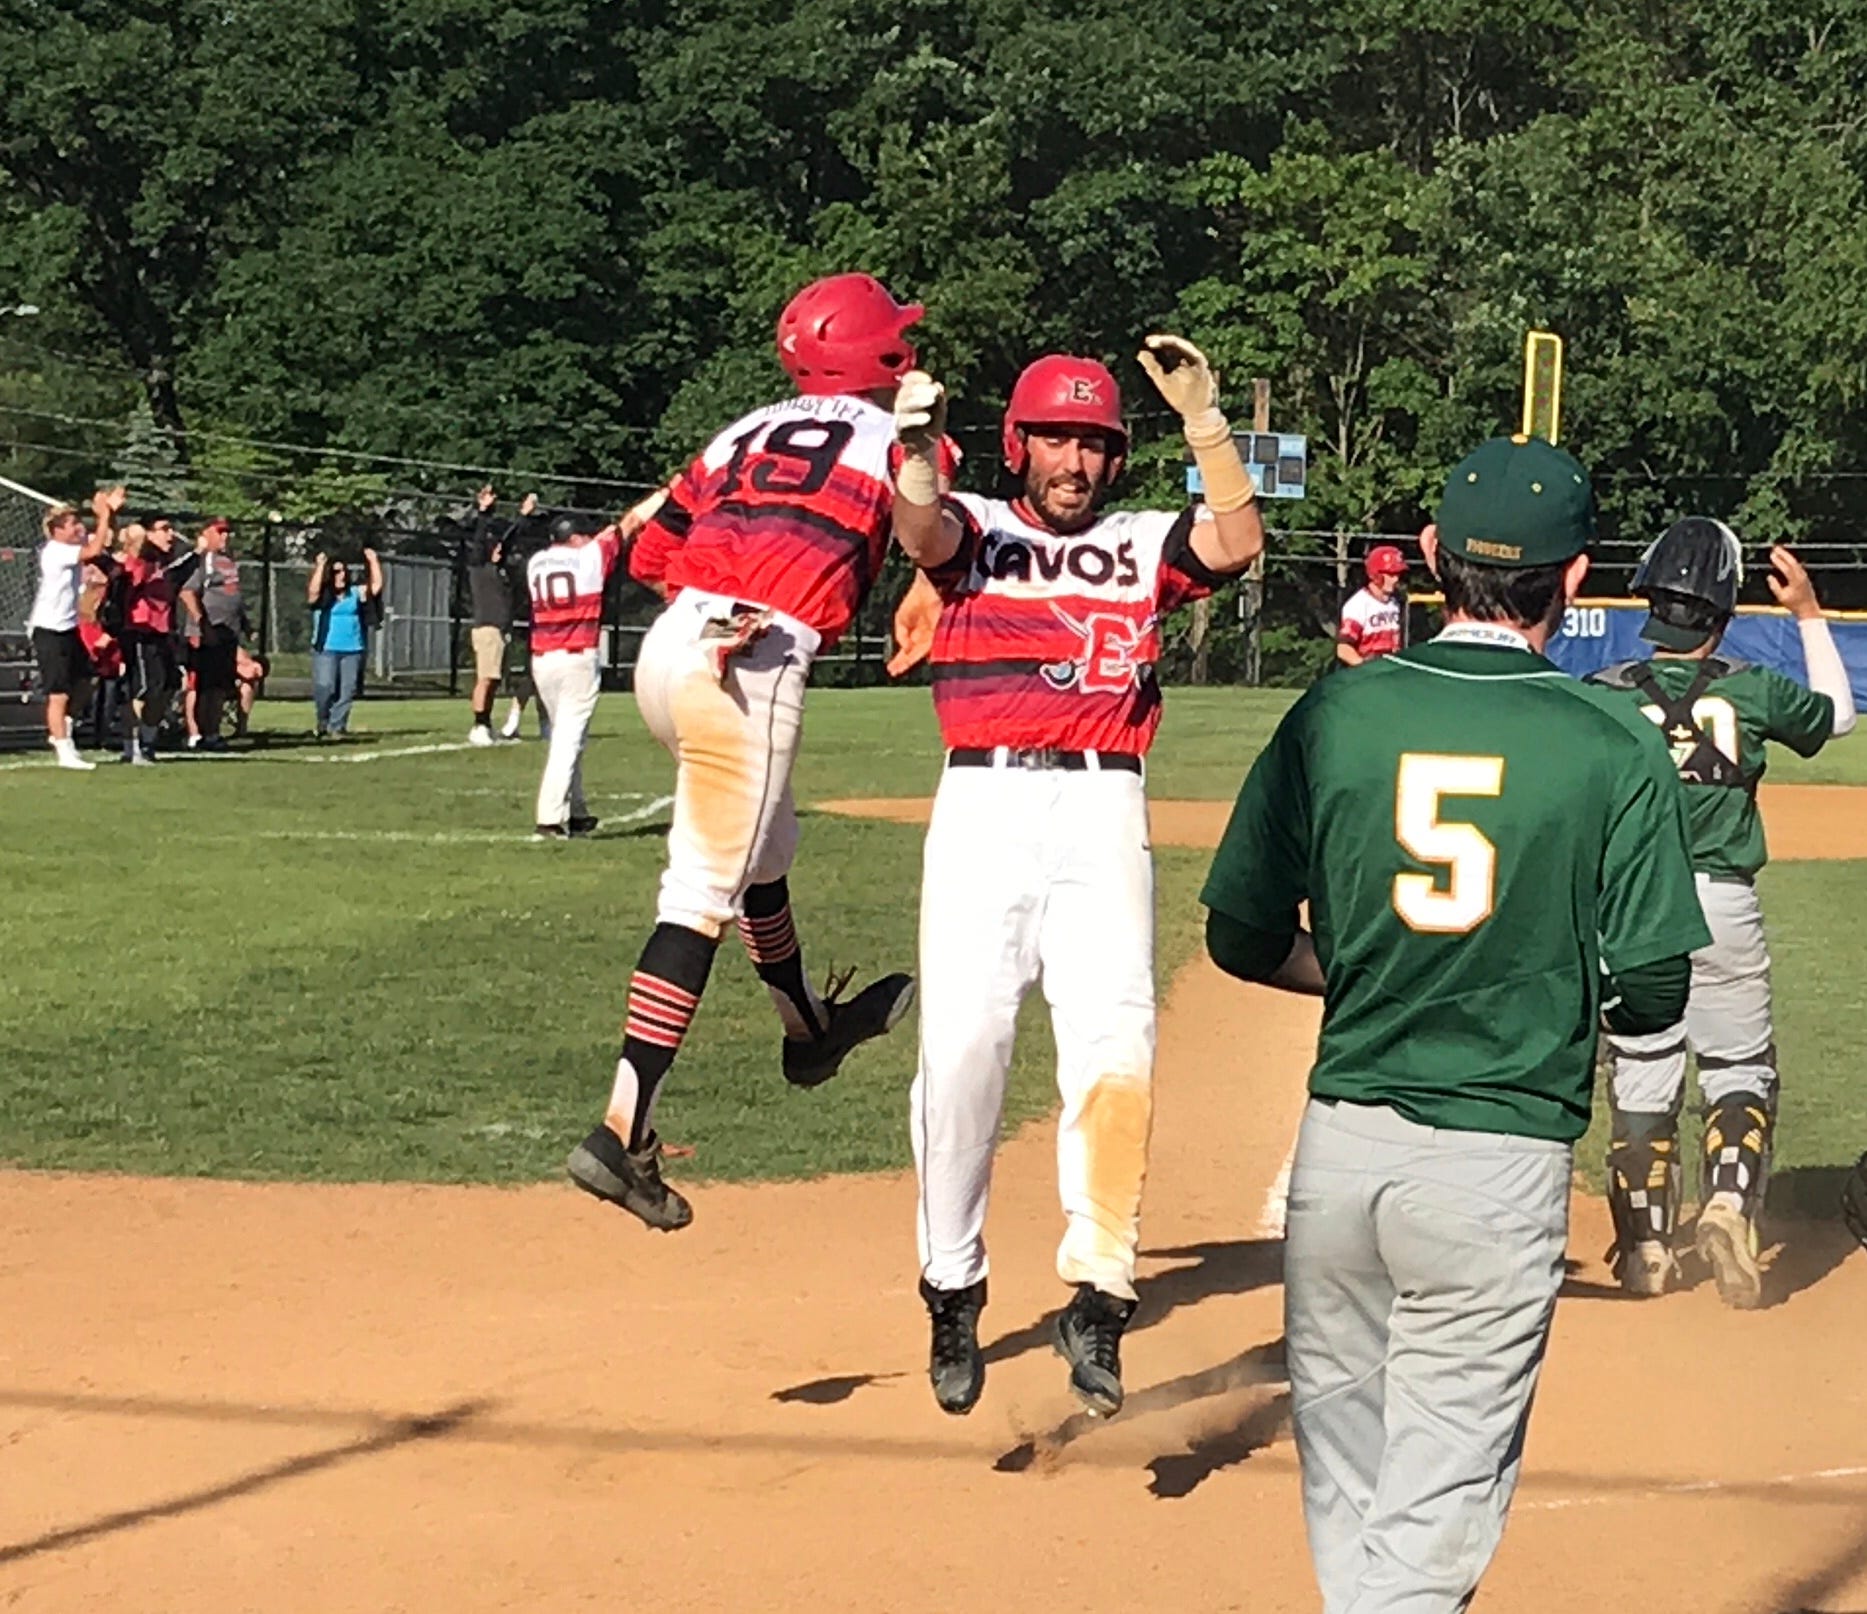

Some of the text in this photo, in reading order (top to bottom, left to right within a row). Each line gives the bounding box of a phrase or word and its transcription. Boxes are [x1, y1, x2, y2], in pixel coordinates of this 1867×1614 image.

[716, 417, 855, 496] 19
[972, 532, 1139, 587] CAVOS
[532, 571, 576, 612] 10
[1562, 606, 1606, 637] 310
[1393, 751, 1506, 934] 5
